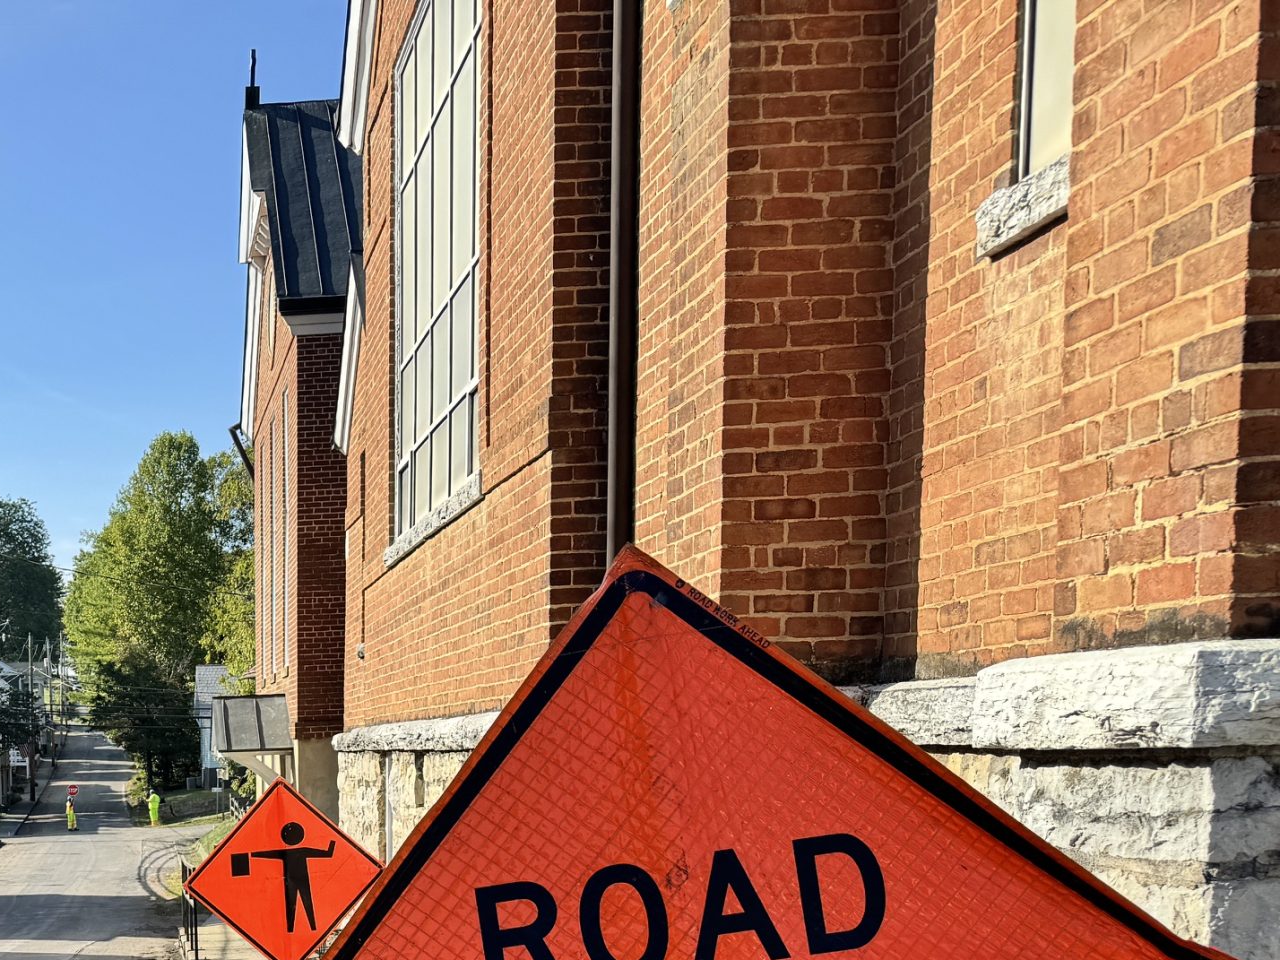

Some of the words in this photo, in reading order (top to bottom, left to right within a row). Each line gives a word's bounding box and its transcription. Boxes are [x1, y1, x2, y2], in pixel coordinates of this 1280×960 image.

[687, 588, 712, 609] ROAD
[713, 605, 740, 627] WORK
[739, 624, 771, 649] AHEAD
